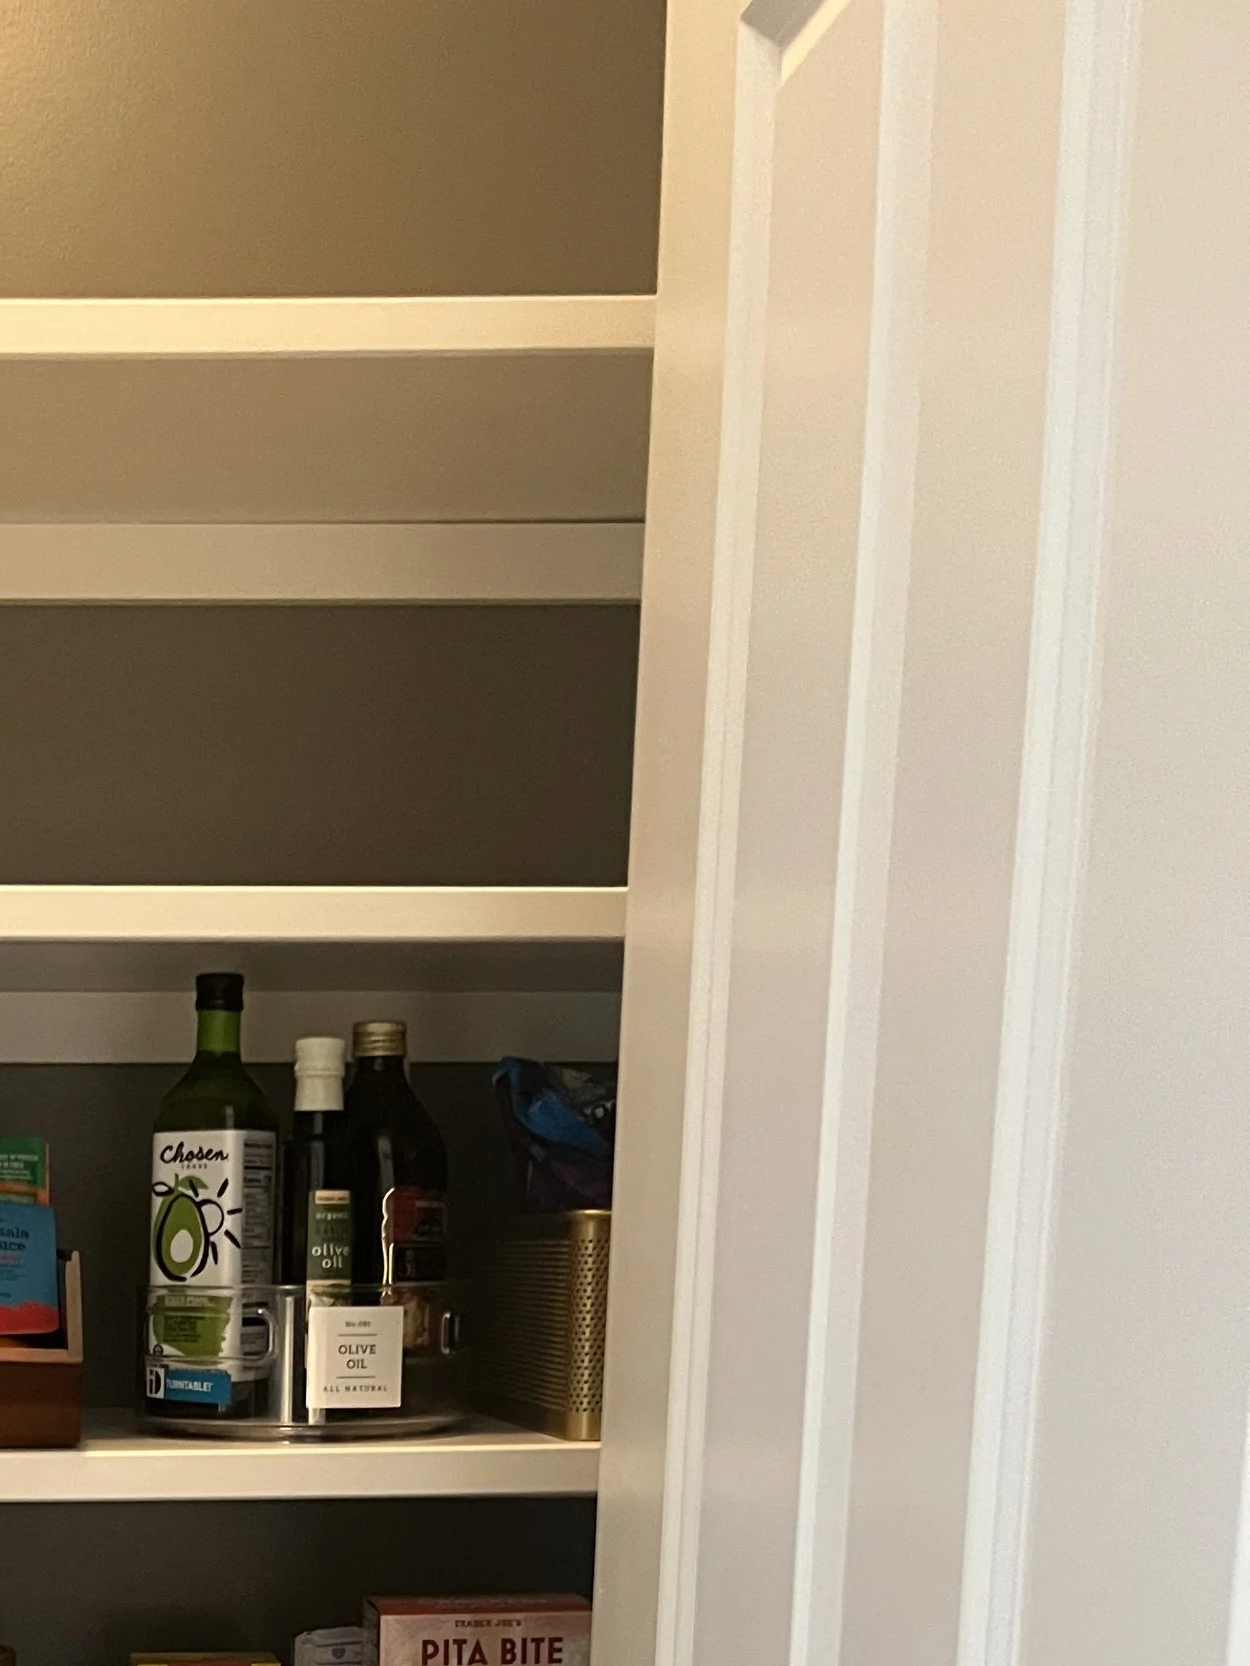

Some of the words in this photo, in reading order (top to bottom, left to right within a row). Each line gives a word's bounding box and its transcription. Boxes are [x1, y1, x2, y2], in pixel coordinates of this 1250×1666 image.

[160, 1141, 229, 1164] Chosen
[311, 1242, 350, 1257] olive
[321, 1258, 343, 1270] oil
[337, 1344, 378, 1356] OLIVE
[345, 1358, 368, 1370] OIL
[323, 1385, 340, 1394] ALL
[344, 1384, 389, 1393] NATURAL
[454, 1619, 492, 1629] TRADER
[421, 1638, 489, 1666] PITA
[500, 1636, 564, 1666] BITE
